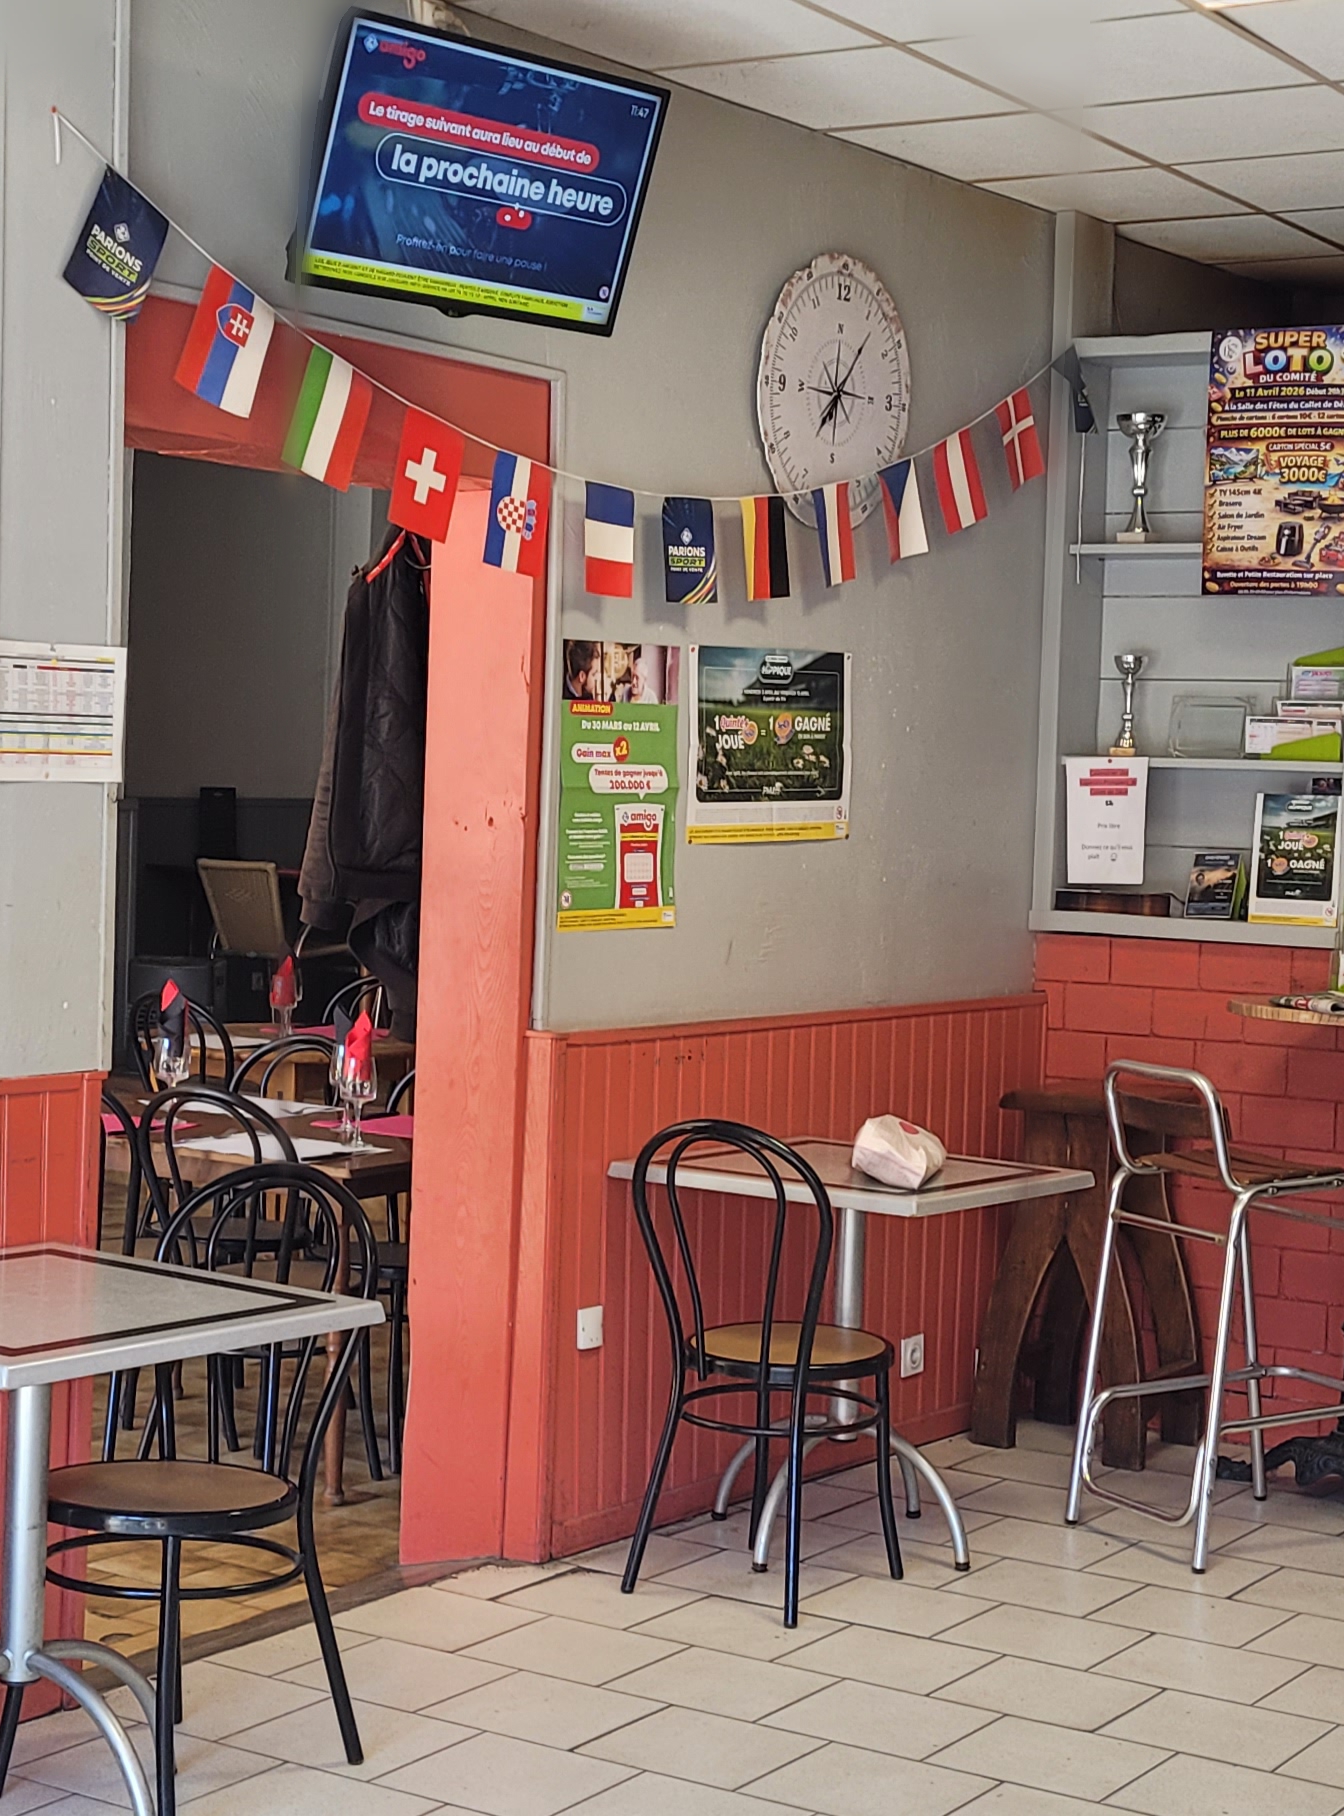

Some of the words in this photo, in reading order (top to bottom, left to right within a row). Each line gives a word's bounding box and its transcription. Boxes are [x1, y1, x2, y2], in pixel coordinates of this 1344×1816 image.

[379, 39, 426, 69] amigo
[369, 101, 384, 117] Le
[386, 105, 424, 127] tirage
[425, 115, 470, 136] suivant
[472, 127, 500, 144] aura
[502, 131, 523, 149] lieu
[524, 139, 539, 153] au
[540, 140, 575, 161] début
[575, 148, 591, 165] de
[391, 144, 415, 173] la
[419, 154, 544, 201] prochaine
[548, 179, 613, 215] heure
[91, 223, 143, 272] PARIONS
[87, 237, 137, 279] SPORT
[449, 245, 473, 260] pour
[473, 248, 494, 263] faire
[495, 254, 513, 266] une
[514, 258, 542, 272] pause
[837, 283, 851, 302] 12
[1256, 331, 1327, 349] SUPER
[1245, 348, 1332, 375] LOTO
[778, 374, 787, 392] 9
[1259, 374, 1273, 383] DU
[1276, 371, 1317, 382] COMITÉ
[1235, 388, 1244, 397] Le
[1246, 388, 1255, 396] 11
[1256, 387, 1279, 397] Avril
[1280, 386, 1304, 396] 2026
[885, 395, 893, 411] 3
[1250, 427, 1286, 438] 6000€
[1279, 456, 1325, 468] VOYAGE
[1280, 468, 1326, 483] 3000€
[668, 545, 706, 558] PARIONS
[670, 558, 704, 566] SPORT
[572, 704, 611, 714] ANIMATION
[581, 720, 591, 729] Du
[592, 721, 601, 729] 30
[602, 721, 622, 731] MARS
[623, 723, 632, 731] au
[633, 722, 640, 731] 12
[640, 722, 660, 732] AVRIL
[714, 716, 720, 729] 1
[769, 716, 774, 730] 1
[794, 713, 831, 731] GAGNÉ
[576, 747, 594, 758] Gain
[615, 740, 628, 756] x2
[716, 732, 745, 749] JOUÉ
[631, 809, 656, 828] amigo
